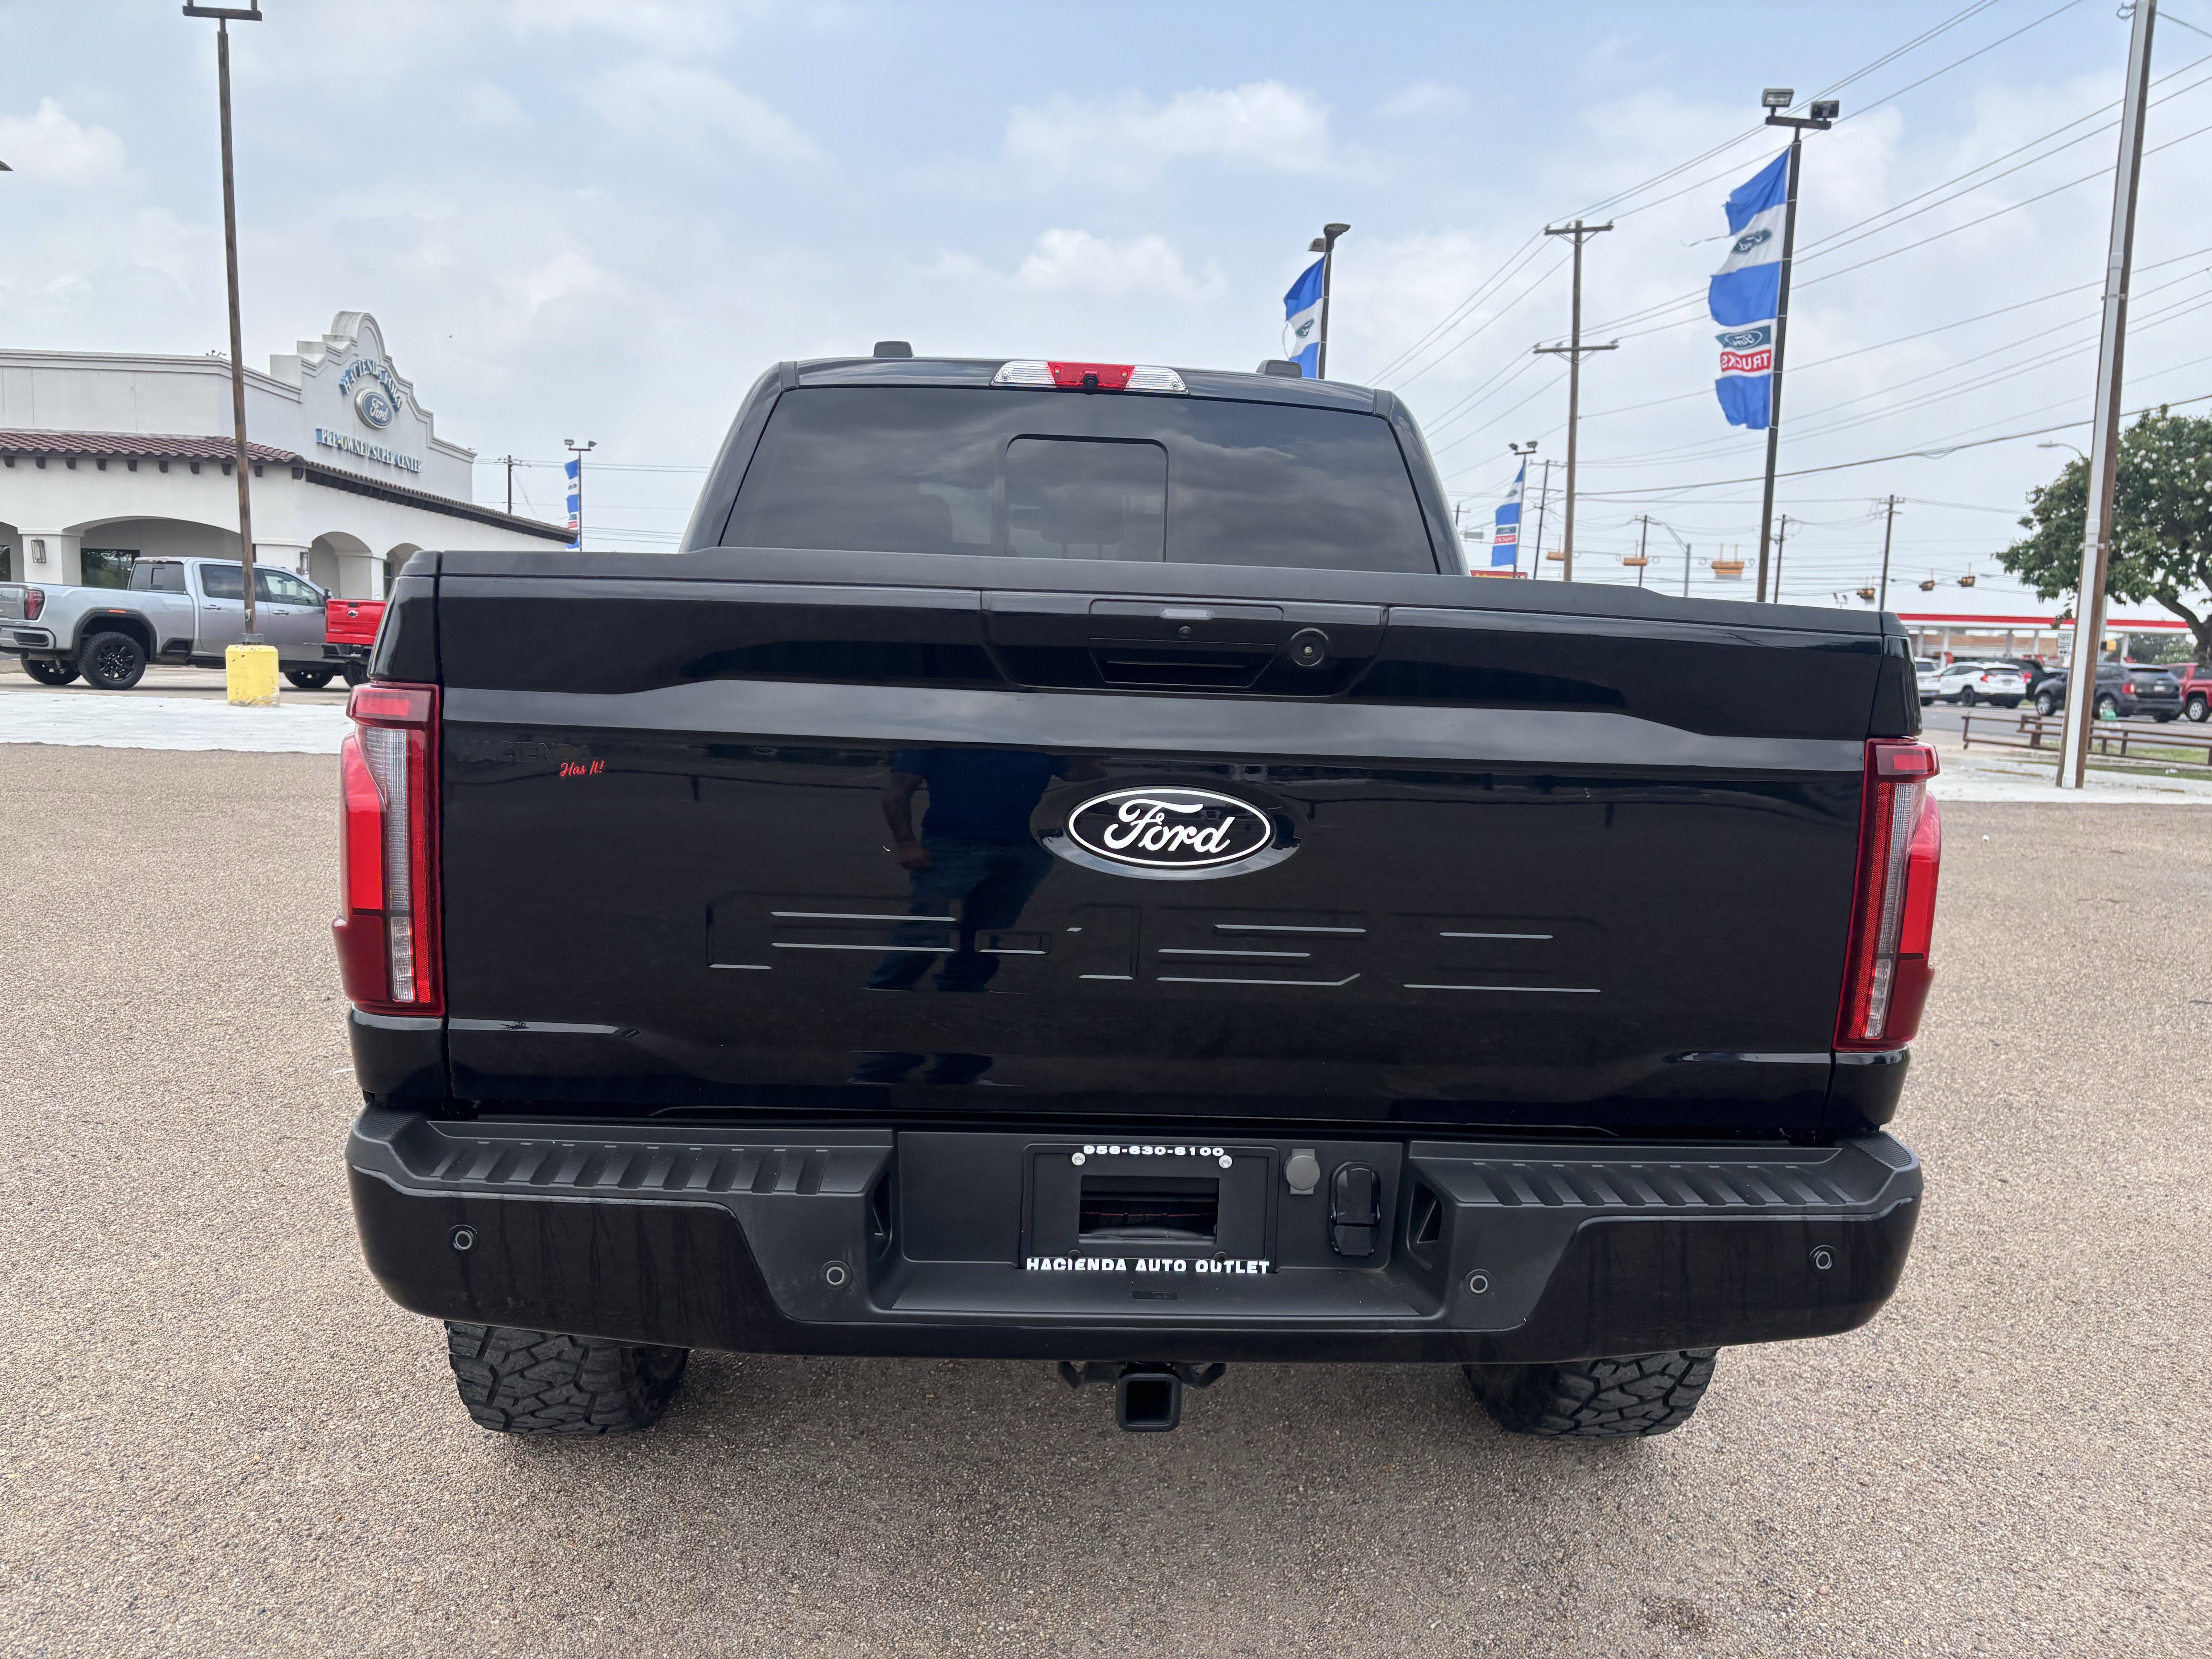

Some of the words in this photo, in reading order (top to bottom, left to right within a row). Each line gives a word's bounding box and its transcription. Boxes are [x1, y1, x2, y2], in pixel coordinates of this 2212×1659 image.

[370, 398, 388, 421] Ford
[316, 428, 370, 457] PRE-OWNED
[371, 445, 396, 465] SUPER
[397, 453, 423, 473] CENTER
[560, 762, 586, 776] Has
[1103, 799, 1235, 853] Ford
[706, 891, 1606, 993] F-150
[1083, 1145, 1224, 1156] 956-630-6100
[1026, 1258, 1127, 1271] HACIENDA
[1135, 1259, 1187, 1272] AUTO
[1195, 1260, 1270, 1274] OUTLET
